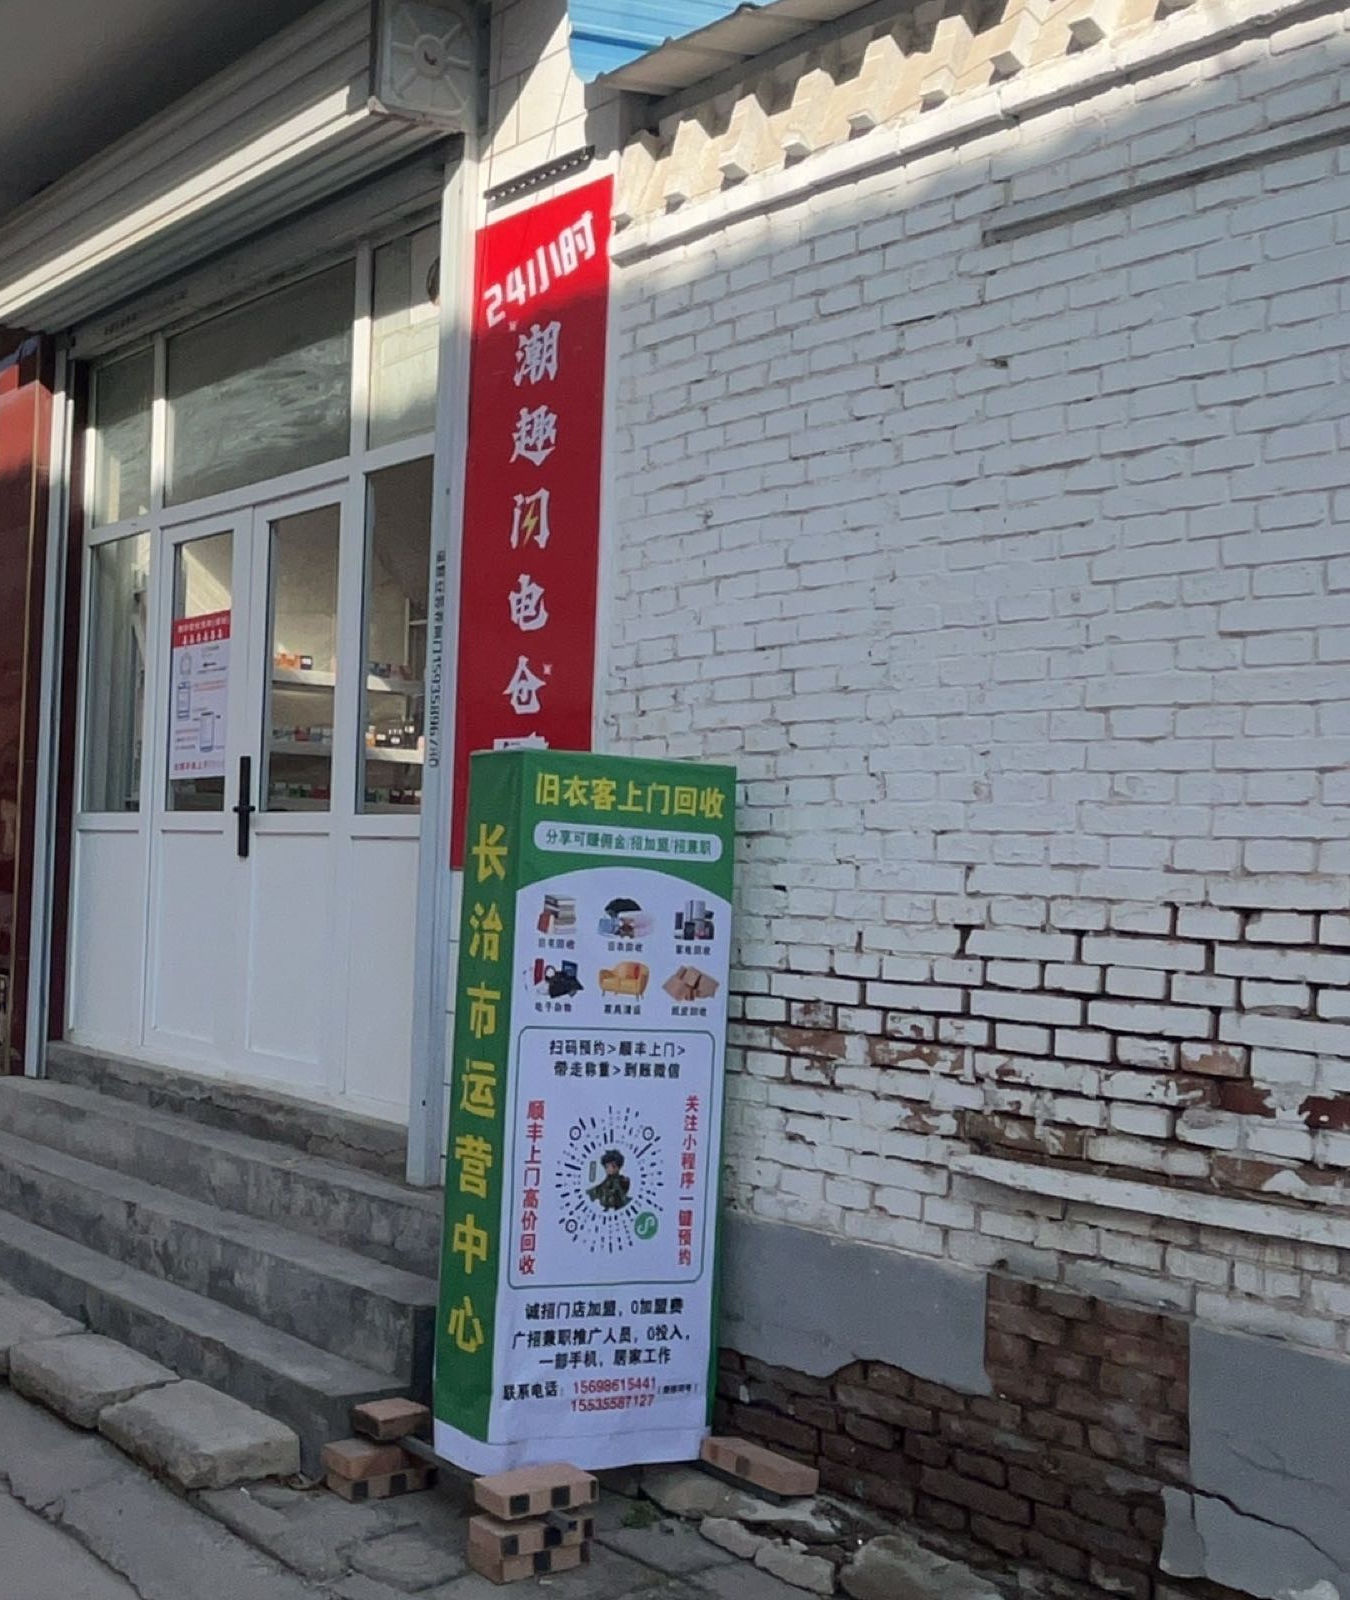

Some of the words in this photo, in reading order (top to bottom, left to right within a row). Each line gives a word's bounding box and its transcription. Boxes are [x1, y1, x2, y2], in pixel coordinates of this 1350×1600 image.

[483, 210, 596, 329] 24小时
[536, 772, 725, 819] 旧衣客上门回收
[449, 822, 508, 1354] 长治市运营中心
[519, 1100, 545, 1275] 顺丰上门高价回收
[678, 1095, 699, 1266] 关注小程序一键预约
[572, 1394, 655, 1413] 15535587127
[574, 1376, 656, 1394] 15698615441
